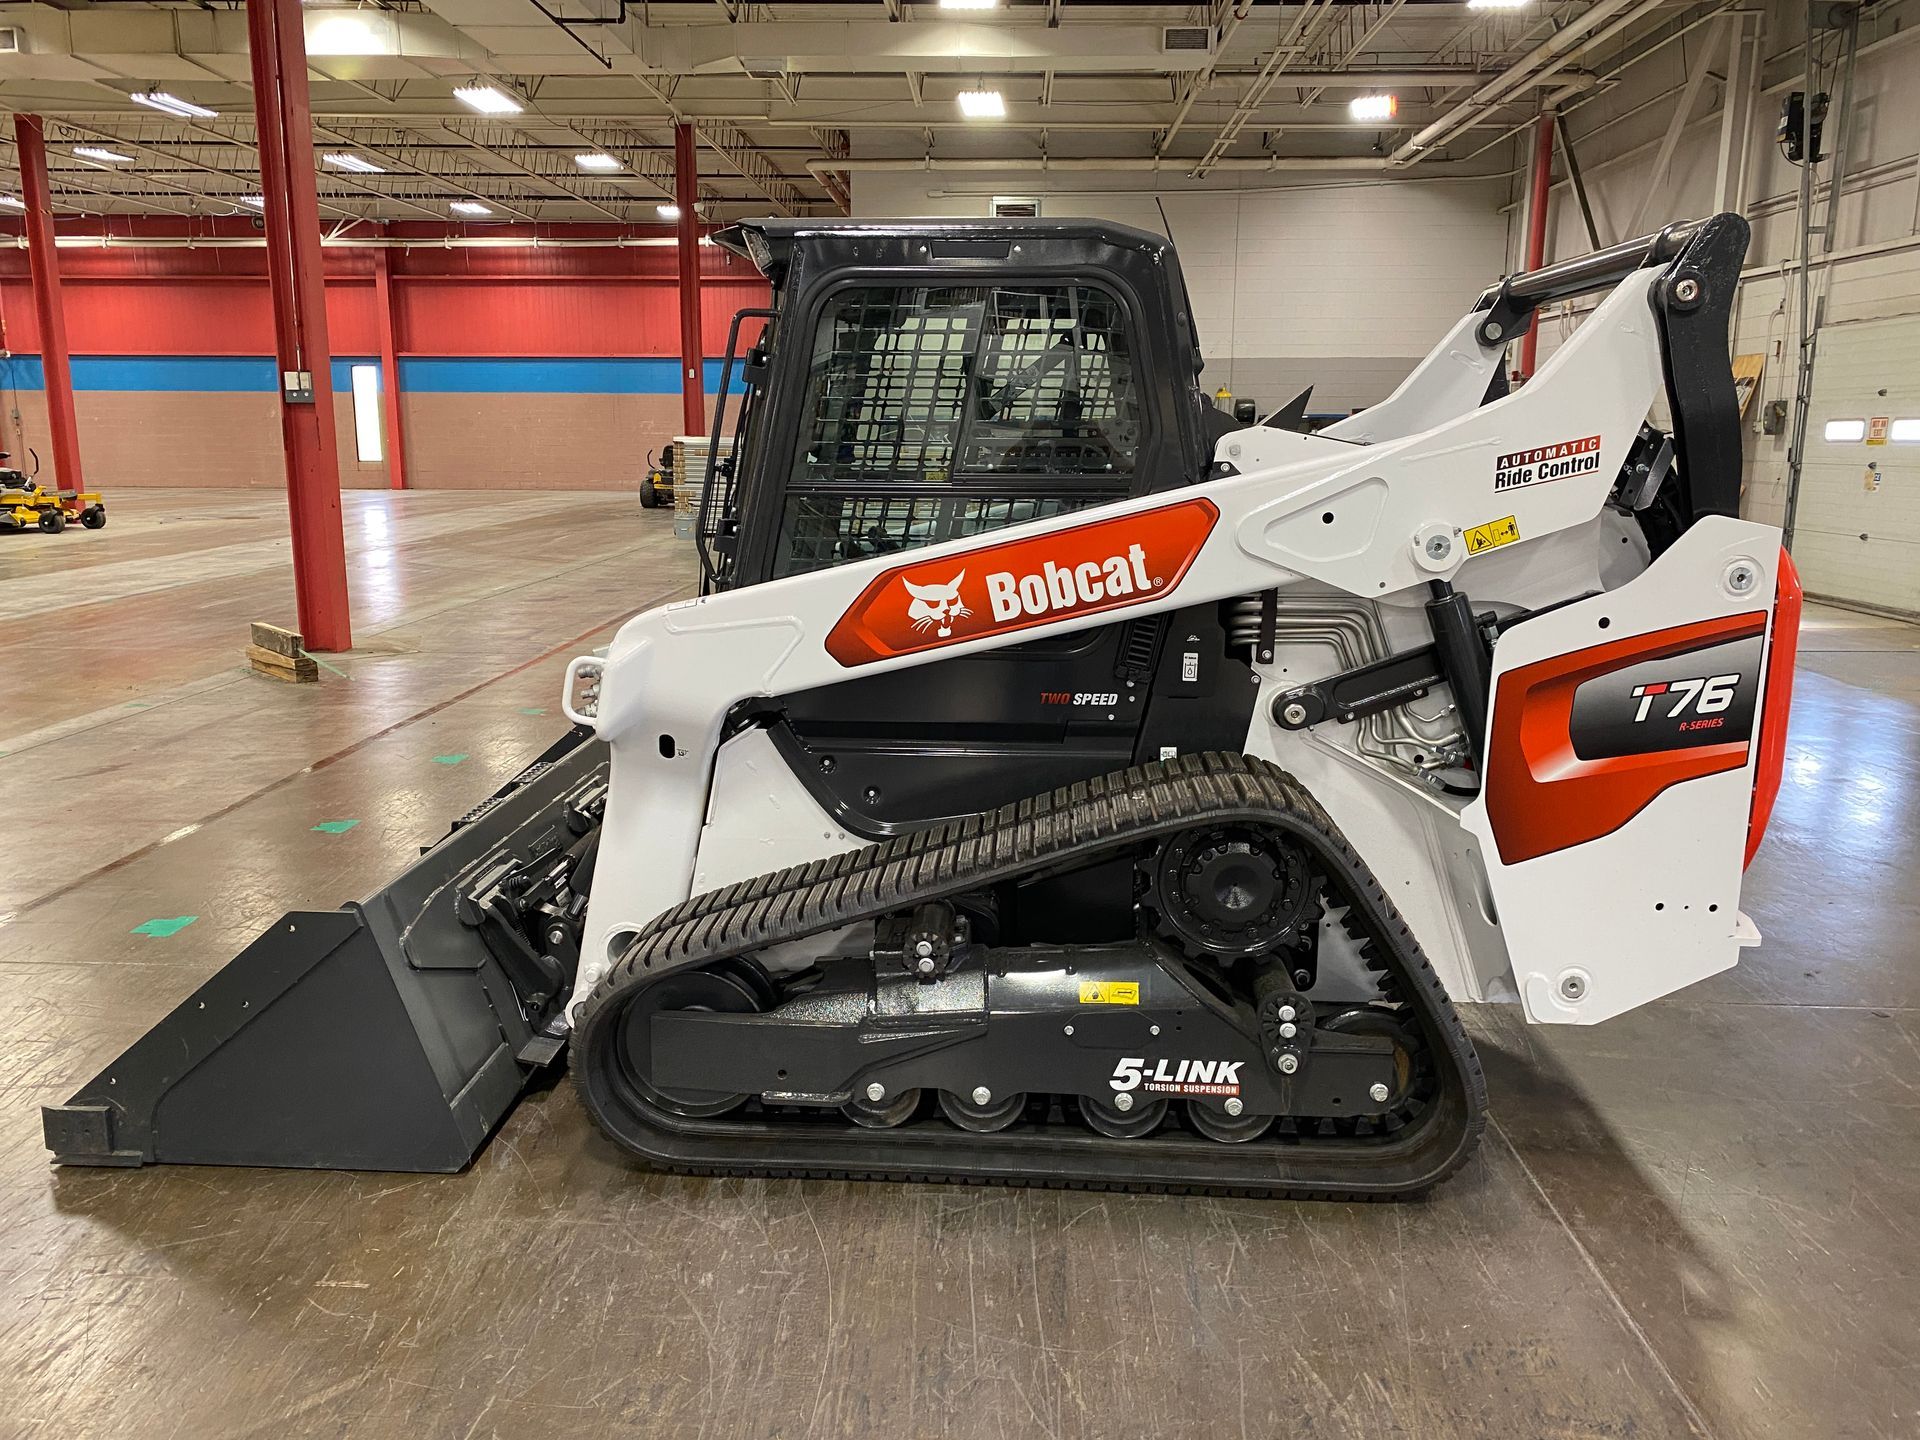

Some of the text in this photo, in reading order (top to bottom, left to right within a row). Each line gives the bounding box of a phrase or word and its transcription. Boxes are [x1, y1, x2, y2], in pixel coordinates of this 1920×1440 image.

[1500, 438, 1597, 469] AUTOMATIC
[1495, 451, 1600, 490] Ride Control
[1040, 692, 1119, 706] TWO SPEED
[1631, 674, 1740, 722] T76
[1679, 717, 1725, 731] R-SERIES
[1109, 1057, 1245, 1091] 5-LINK
[1144, 1082, 1238, 1095] TORSION SUSPENSION
